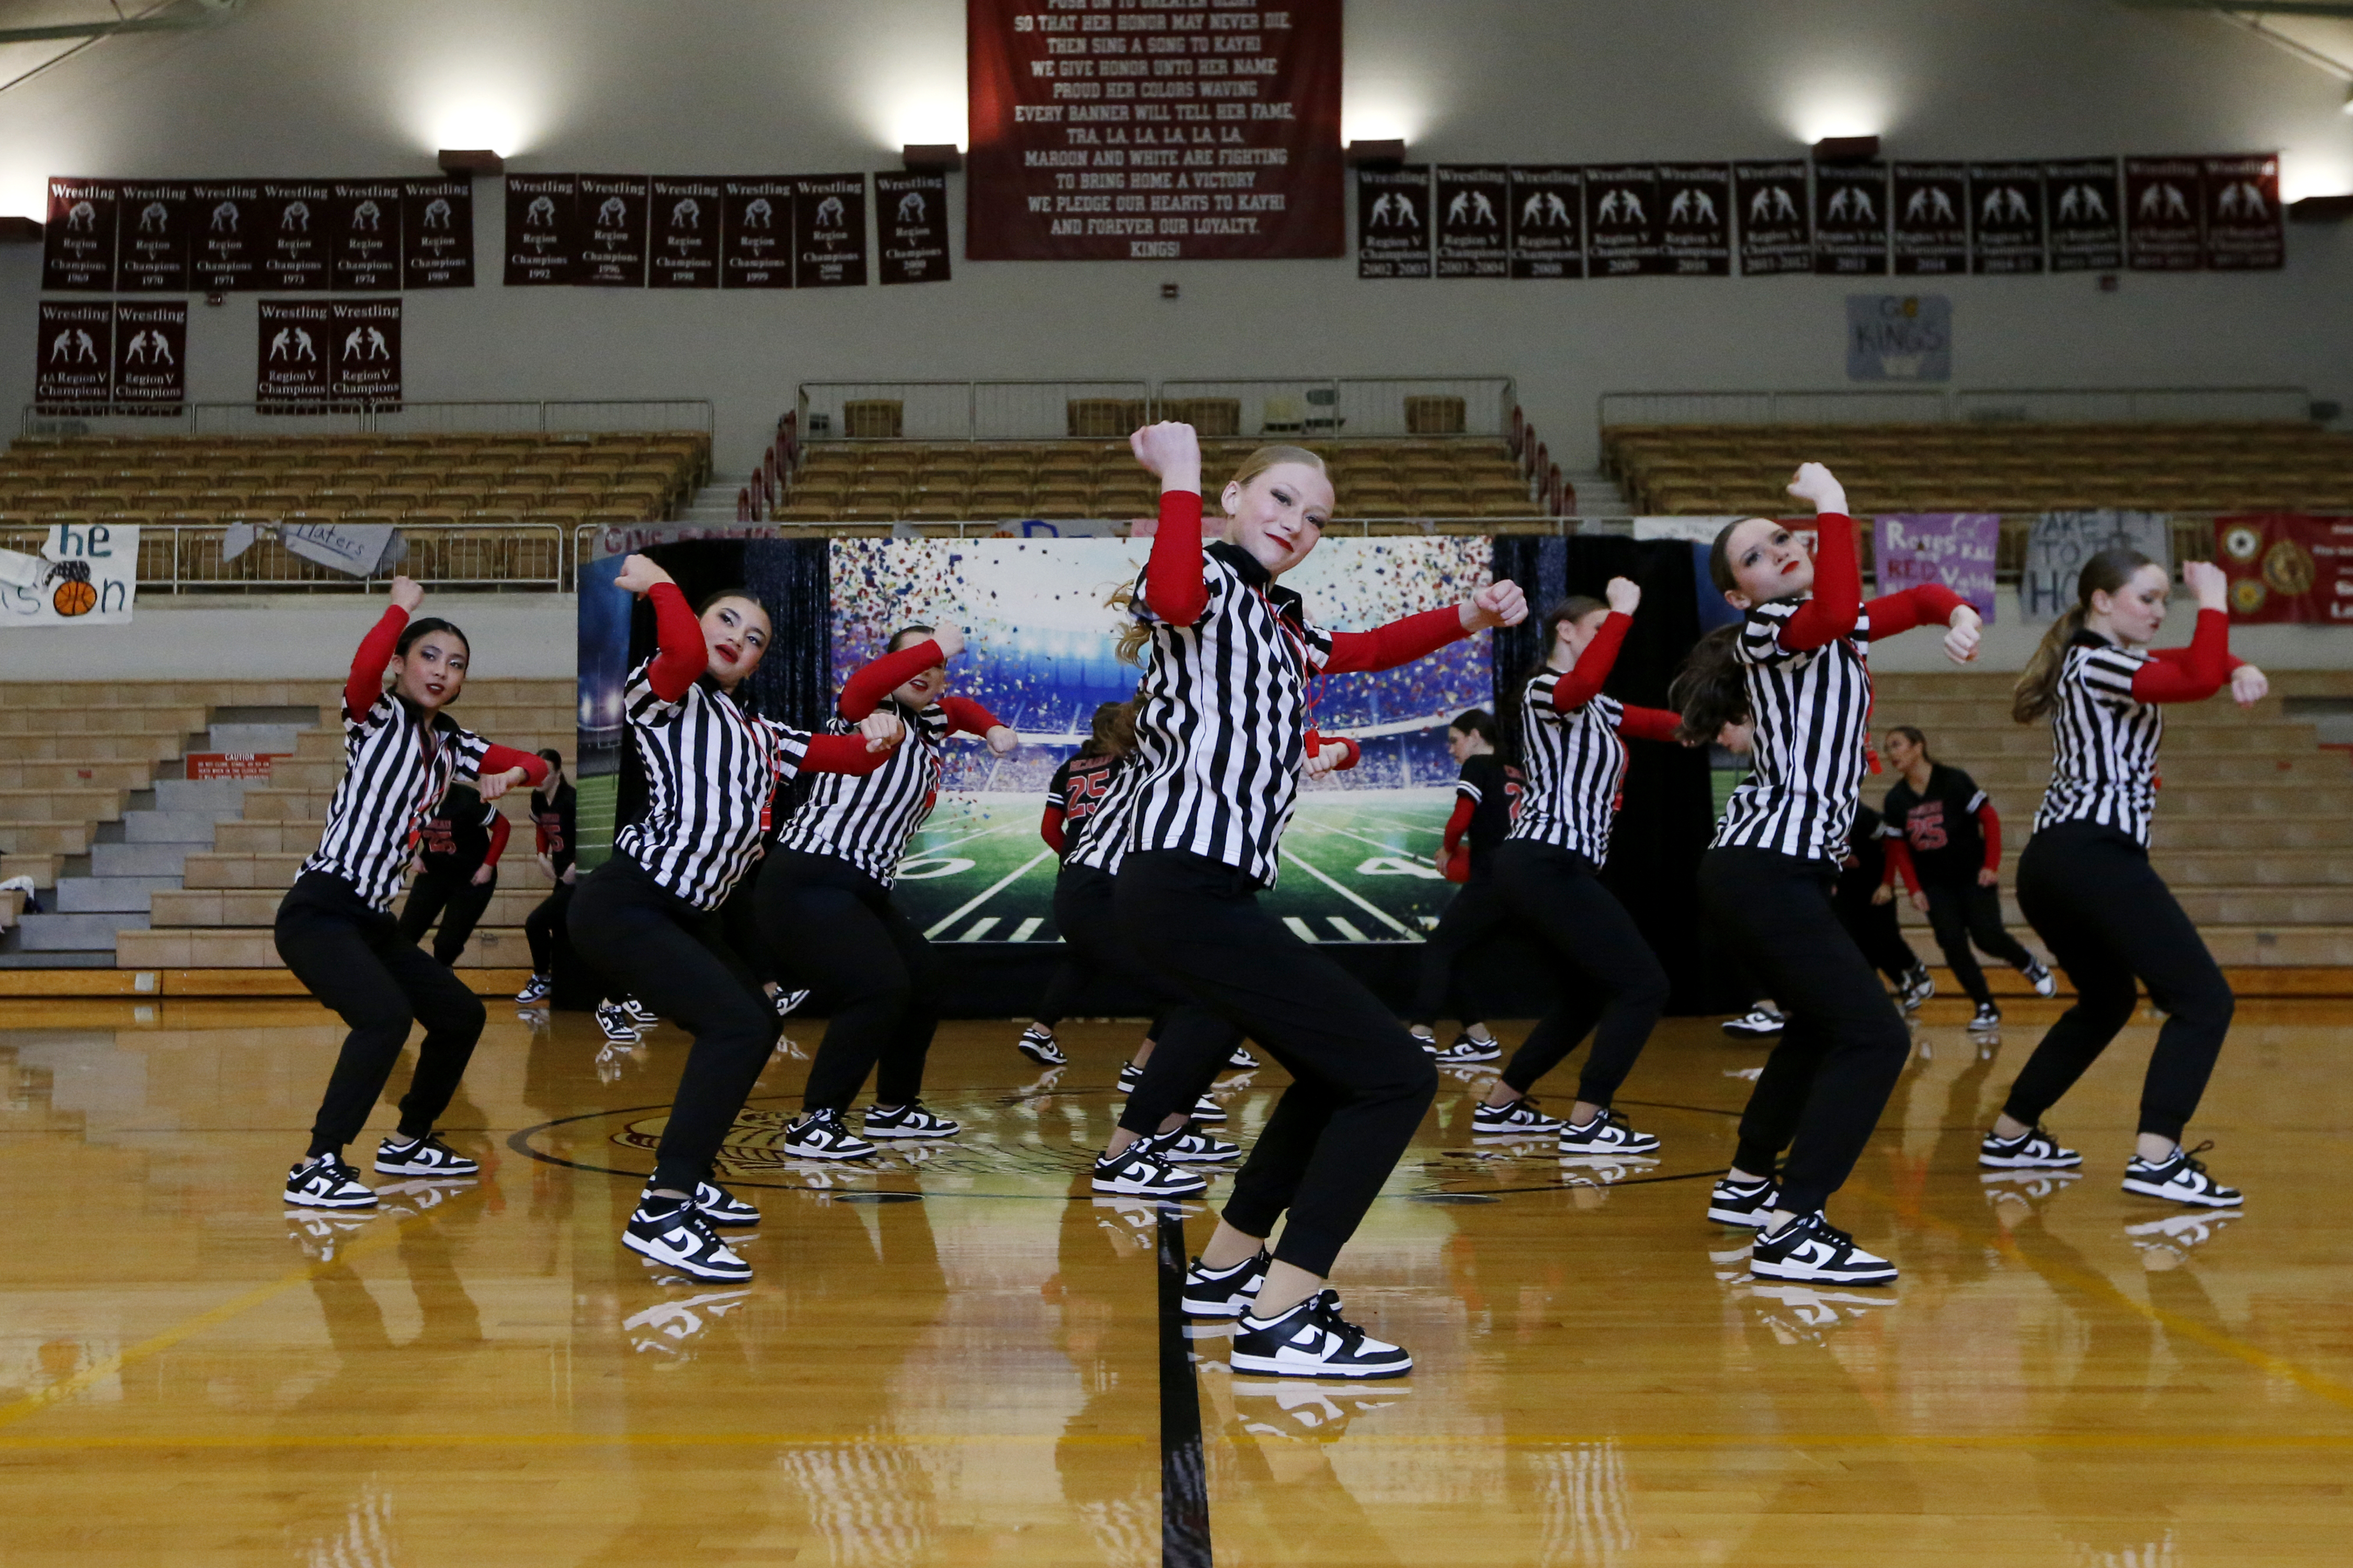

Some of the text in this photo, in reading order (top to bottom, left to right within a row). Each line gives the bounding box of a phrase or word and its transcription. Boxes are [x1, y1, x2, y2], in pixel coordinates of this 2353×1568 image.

[1014, 15, 1033, 31] SO
[1037, 15, 1078, 31] THAT
[1081, 15, 1112, 31] HER
[1117, 14, 1167, 31] HONOR
[1171, 14, 1205, 30] MAY
[1209, 13, 1259, 29] NEVER
[1046, 38, 1087, 54] THEN
[1091, 37, 1126, 54] SING
[1130, 37, 1143, 53] A
[1146, 37, 1186, 53] SONG
[1189, 36, 1209, 53] TO
[1031, 58, 1278, 77] WE GIVE HONOR UNTO HER NAME
[1053, 81, 1258, 98] PROUD HER COLORS WAVING
[1015, 105, 1064, 121] EVERY
[1069, 105, 1129, 121] BANNER
[1134, 105, 1171, 121] WILL
[1174, 104, 1212, 120] TELL
[1216, 103, 1247, 120] HER
[1024, 148, 1288, 166] MAROON AND WHITE ARE FIGHTING
[509, 179, 573, 194] Wrestling
[797, 181, 862, 194] Wrestling
[878, 177, 943, 190] Wrestling
[1055, 171, 1256, 189] TO BRING HOME A VICTORY
[52, 184, 115, 201] Wrestling
[123, 186, 187, 201] Wrestling
[193, 185, 257, 200] Wrestling
[265, 185, 328, 200] Wrestling
[335, 184, 398, 199] Wrestling
[405, 182, 469, 196] Wrestling
[582, 180, 645, 196] Wrestling
[655, 182, 718, 198] Wrestling
[726, 182, 791, 197] Wrestling
[1027, 196, 1052, 212] WE
[1056, 196, 1111, 212] PLEDGE
[1116, 195, 1146, 212] OUR
[1150, 194, 1209, 211] HEARTS
[1213, 194, 1232, 211] TO
[1051, 218, 1082, 235] AND
[1087, 218, 1155, 235] FOREVER
[1159, 218, 1189, 234] OUR
[421, 236, 455, 247] Region
[523, 233, 557, 244] Region
[595, 230, 629, 241] Region
[668, 235, 702, 246] Region
[741, 236, 775, 247] Region
[63, 238, 97, 249] Region
[136, 239, 170, 251] Region
[208, 239, 243, 250] Region
[277, 238, 312, 250] Region
[349, 238, 383, 250] Region
[214, 275, 234, 285] 1971
[42, 306, 110, 323] Wrestling
[118, 306, 185, 325] Wrestling
[261, 304, 327, 321] Wrestling
[333, 304, 399, 319] Wrestling
[58, 372, 96, 386] Region
[97, 372, 107, 382] V
[125, 372, 175, 387] Region V
[269, 370, 317, 383] Region V
[342, 369, 391, 383] Region V
[39, 385, 107, 398] Champions
[116, 384, 181, 399] Champions
[259, 381, 325, 395] Champions
[333, 381, 399, 395] Champions
[225, 753, 255, 761] CAUTION
[1066, 769, 1110, 821] 25
[1906, 814, 1948, 851] 25
